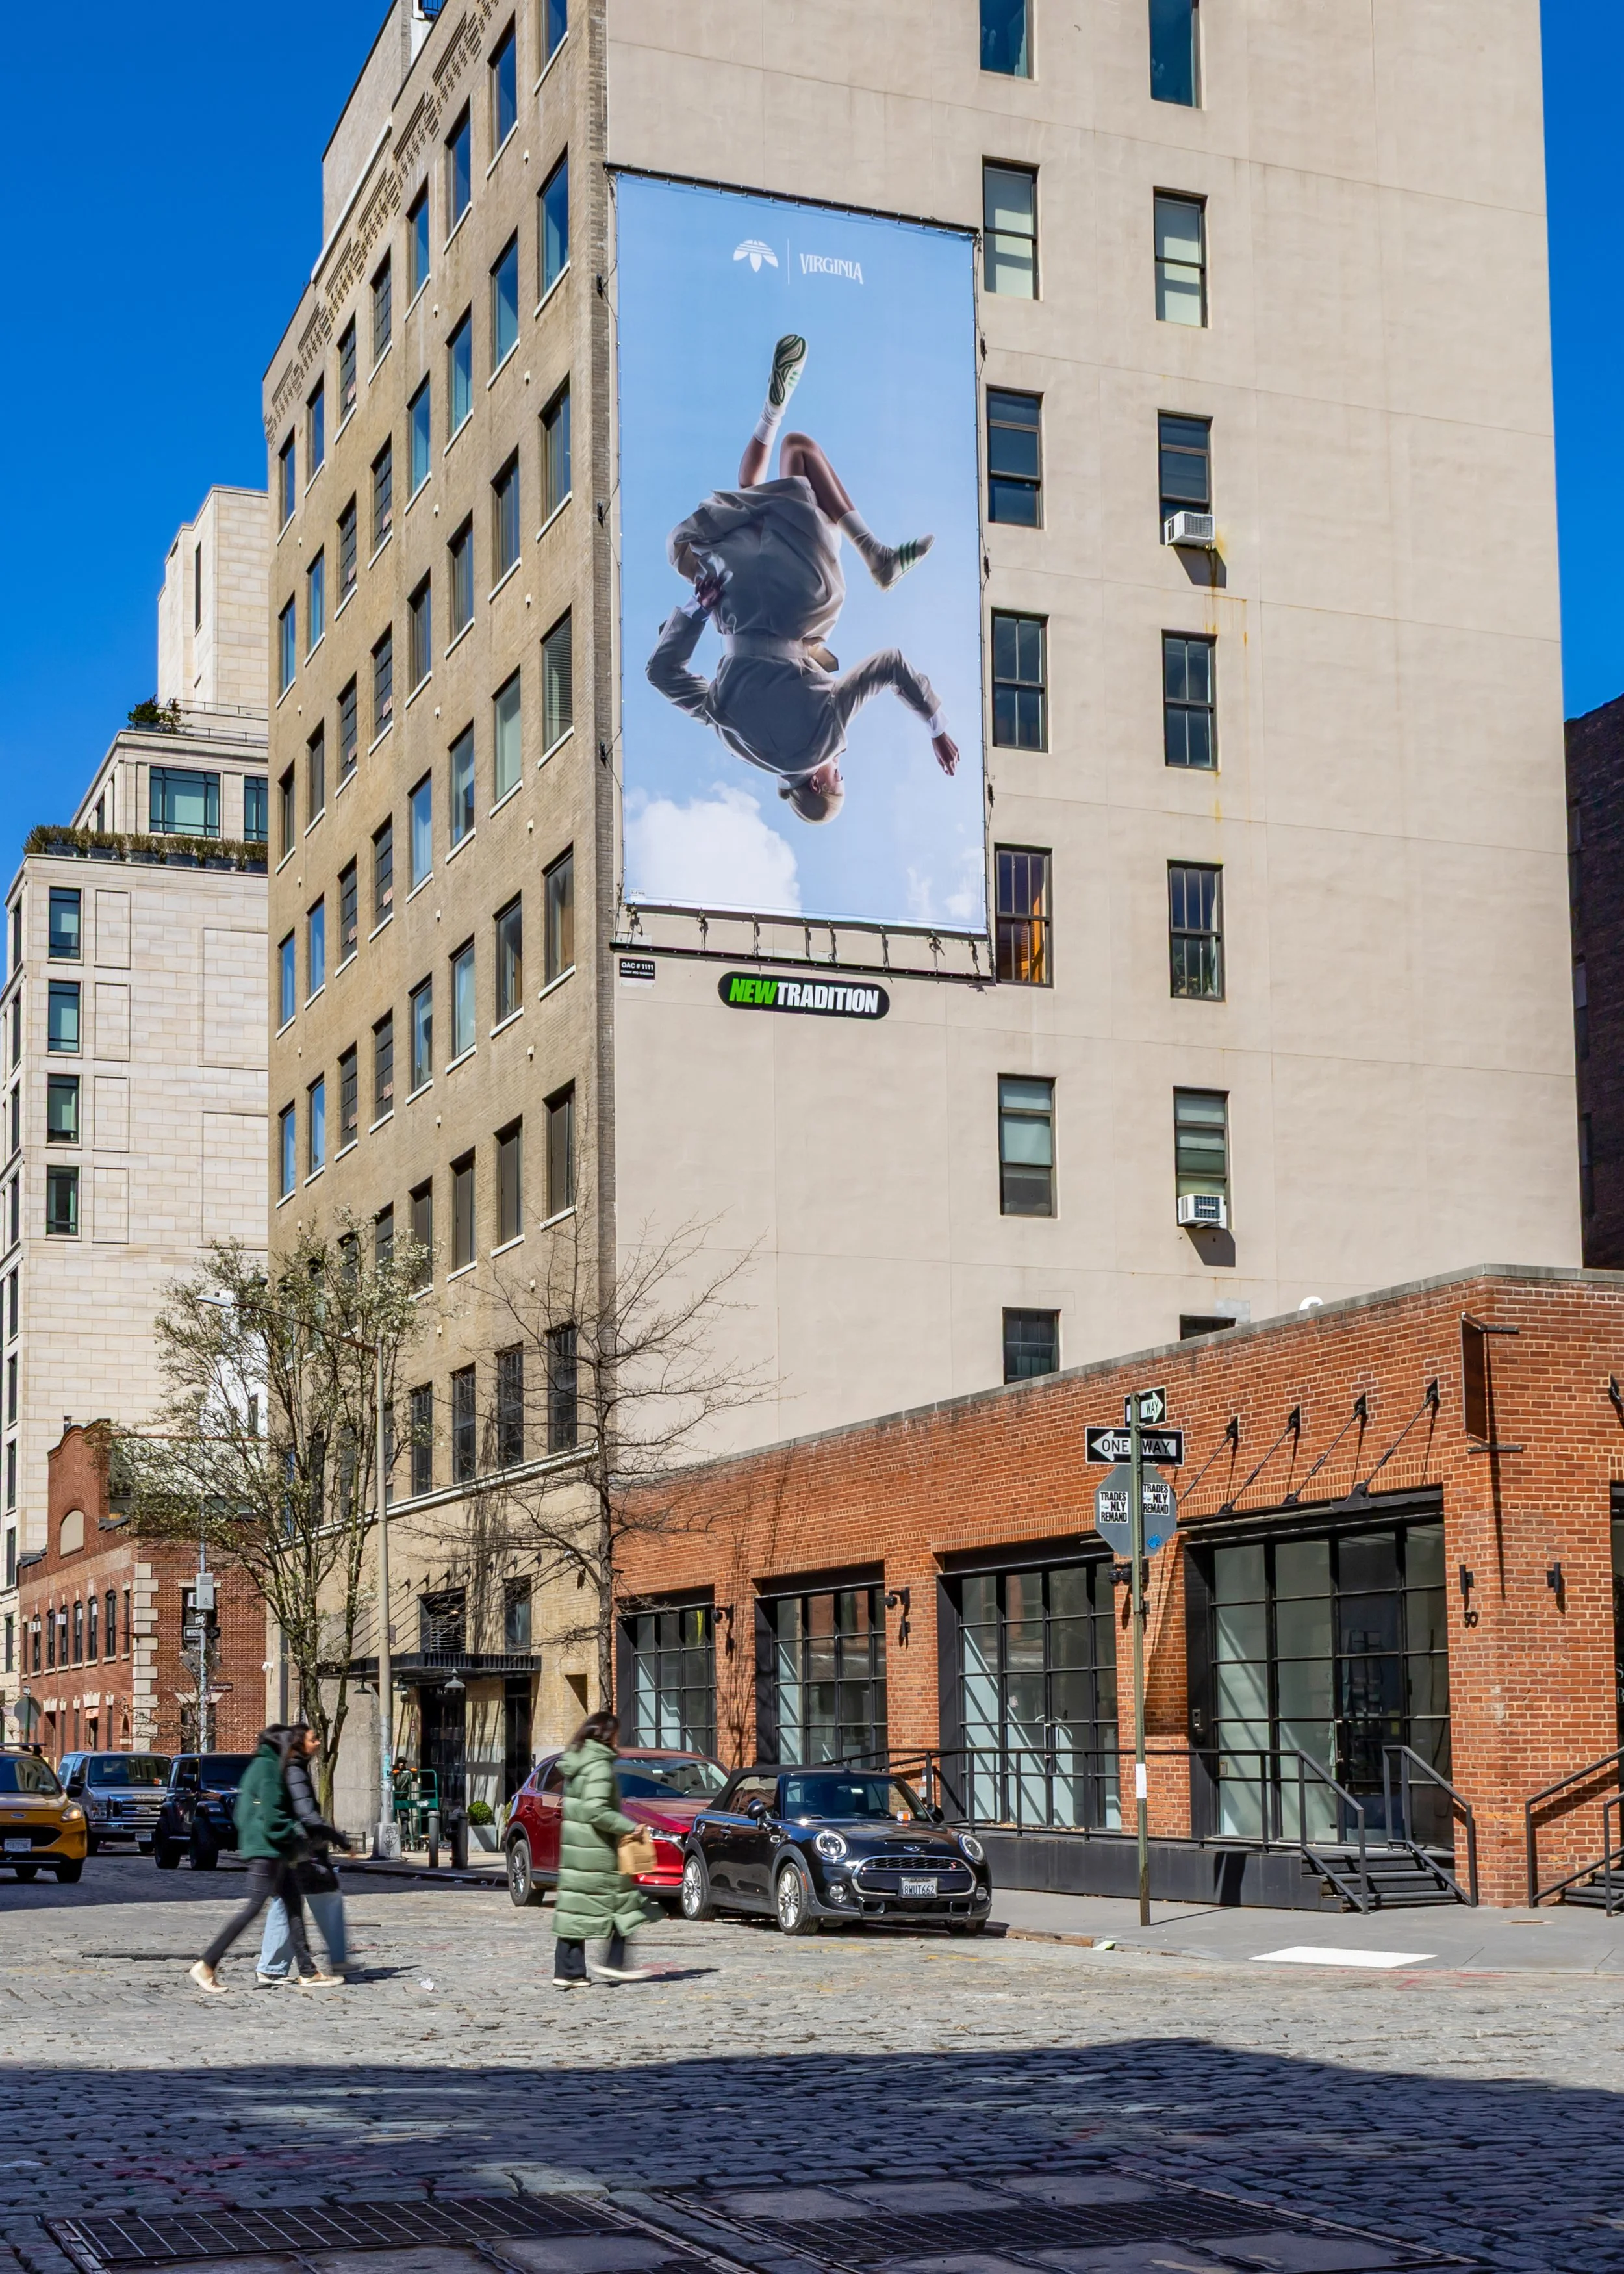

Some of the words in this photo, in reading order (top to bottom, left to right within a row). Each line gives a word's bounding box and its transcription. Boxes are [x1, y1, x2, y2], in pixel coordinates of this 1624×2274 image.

[800, 253, 863, 285] VIRGINIA
[1146, 1400, 1159, 1415] WAY
[1102, 1439, 1129, 1453] ONE
[1143, 1440, 1171, 1454] WAY
[1143, 1483, 1169, 1494] TRADES
[1100, 1492, 1126, 1501] TRADES
[1143, 1503, 1169, 1514] REMAND
[1101, 1512, 1127, 1522] REMAND
[904, 1885, 935, 1895] 8WUT662
